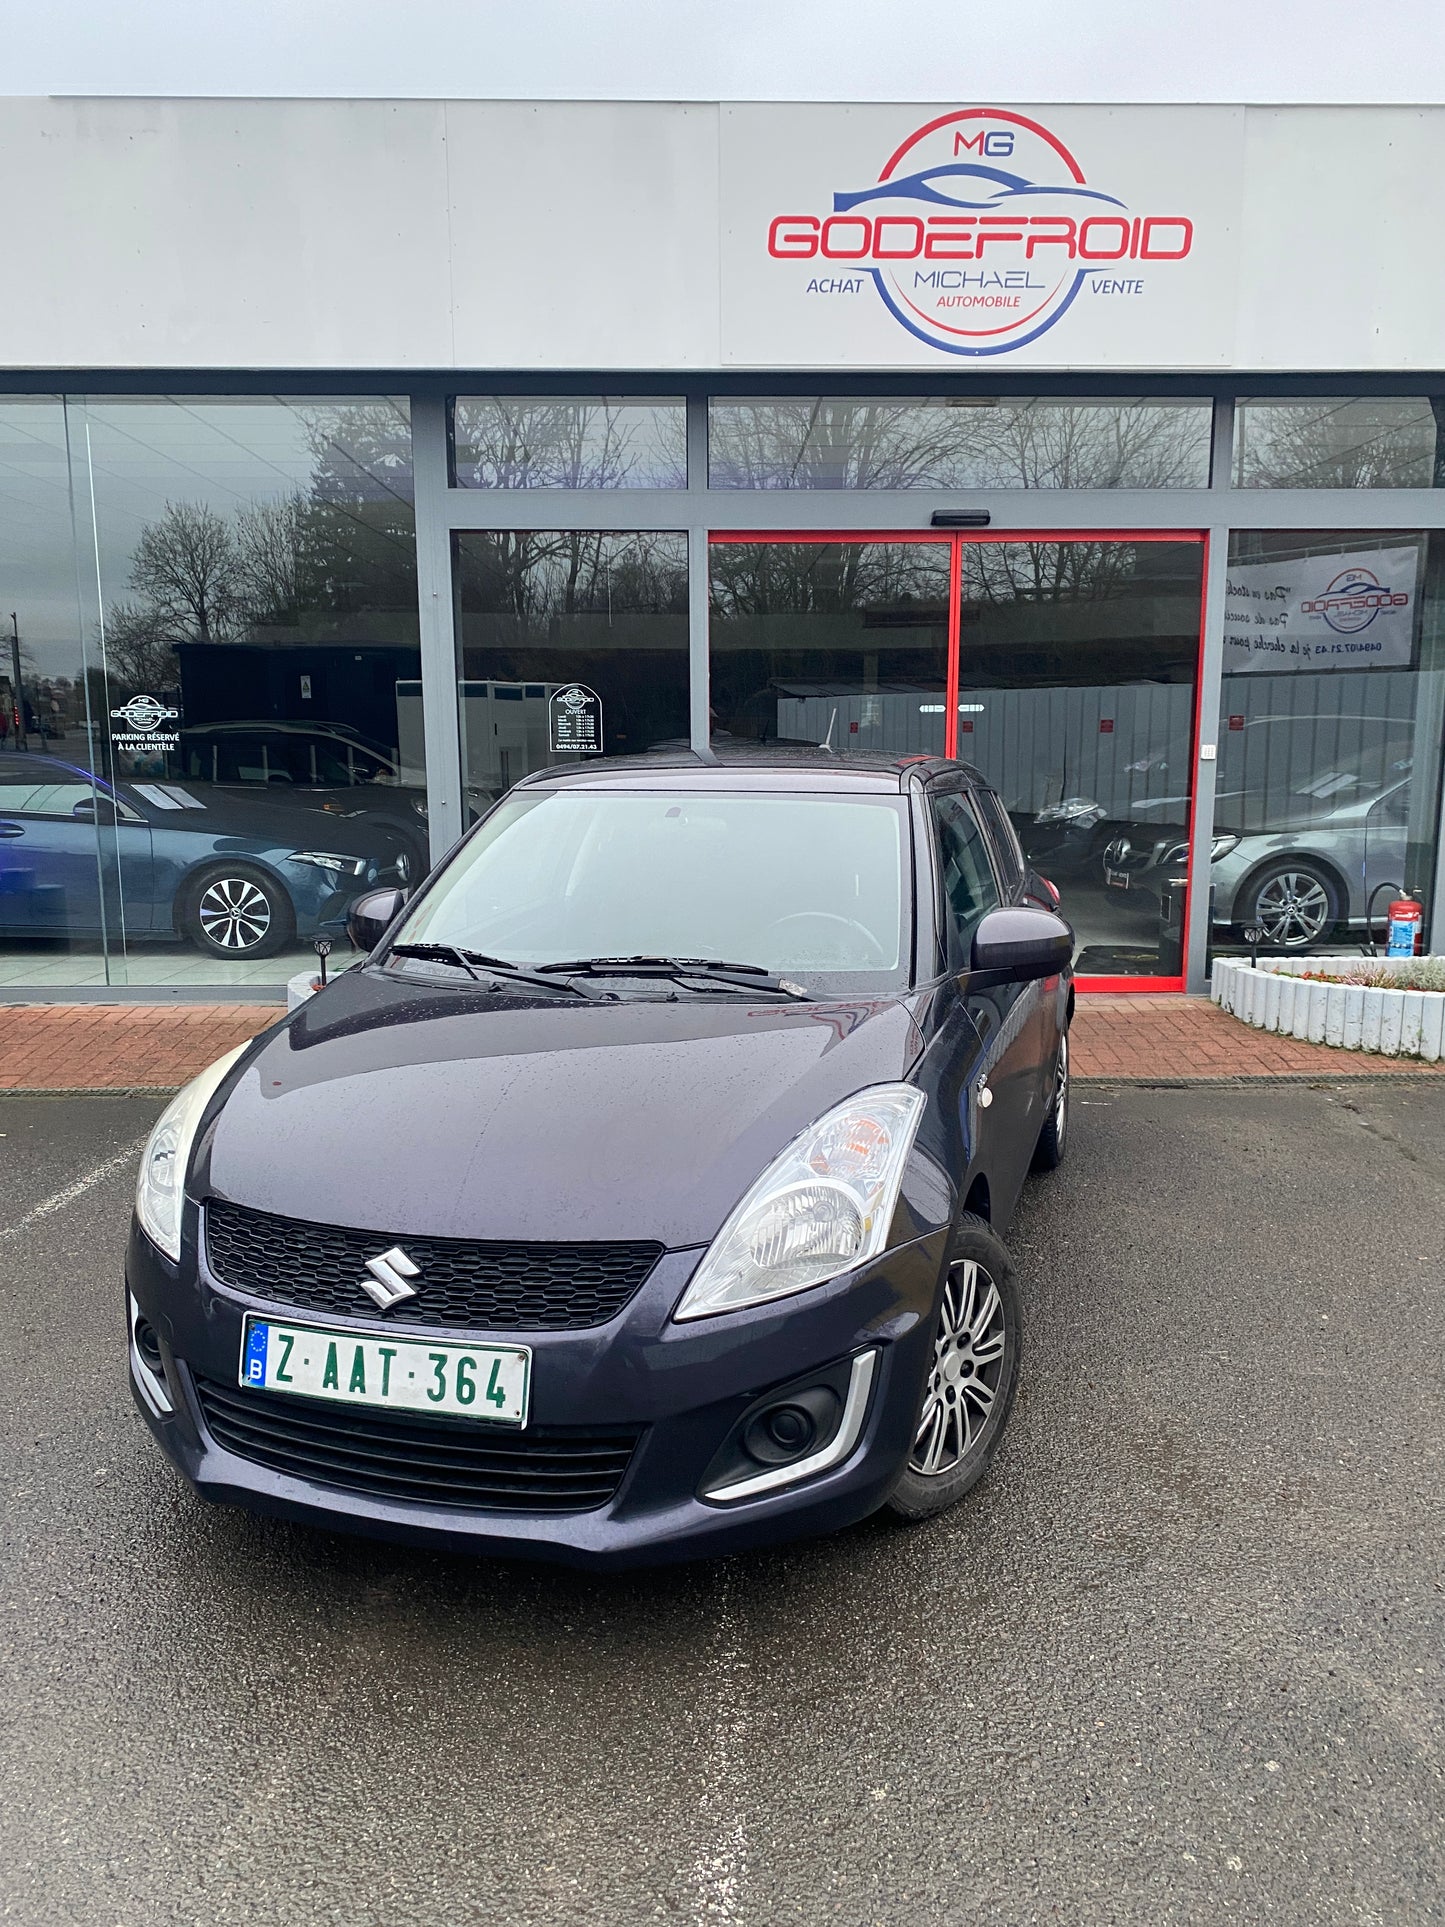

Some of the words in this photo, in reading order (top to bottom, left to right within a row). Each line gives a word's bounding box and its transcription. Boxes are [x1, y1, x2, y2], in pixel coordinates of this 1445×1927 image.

[953, 131, 1015, 157] MG
[768, 216, 1194, 260] GODEFROID
[806, 278, 864, 294] ACHAT
[914, 270, 1046, 289] MICHAEL
[1092, 279, 1144, 295] VENTE
[936, 295, 1021, 308] AUTOMOBILE
[111, 733, 146, 741] PARKING
[147, 731, 180, 741] RÉSERVÉ
[117, 741, 124, 750] À
[136, 741, 175, 751] CLIENTÈLE
[249, 1358, 263, 1380] B
